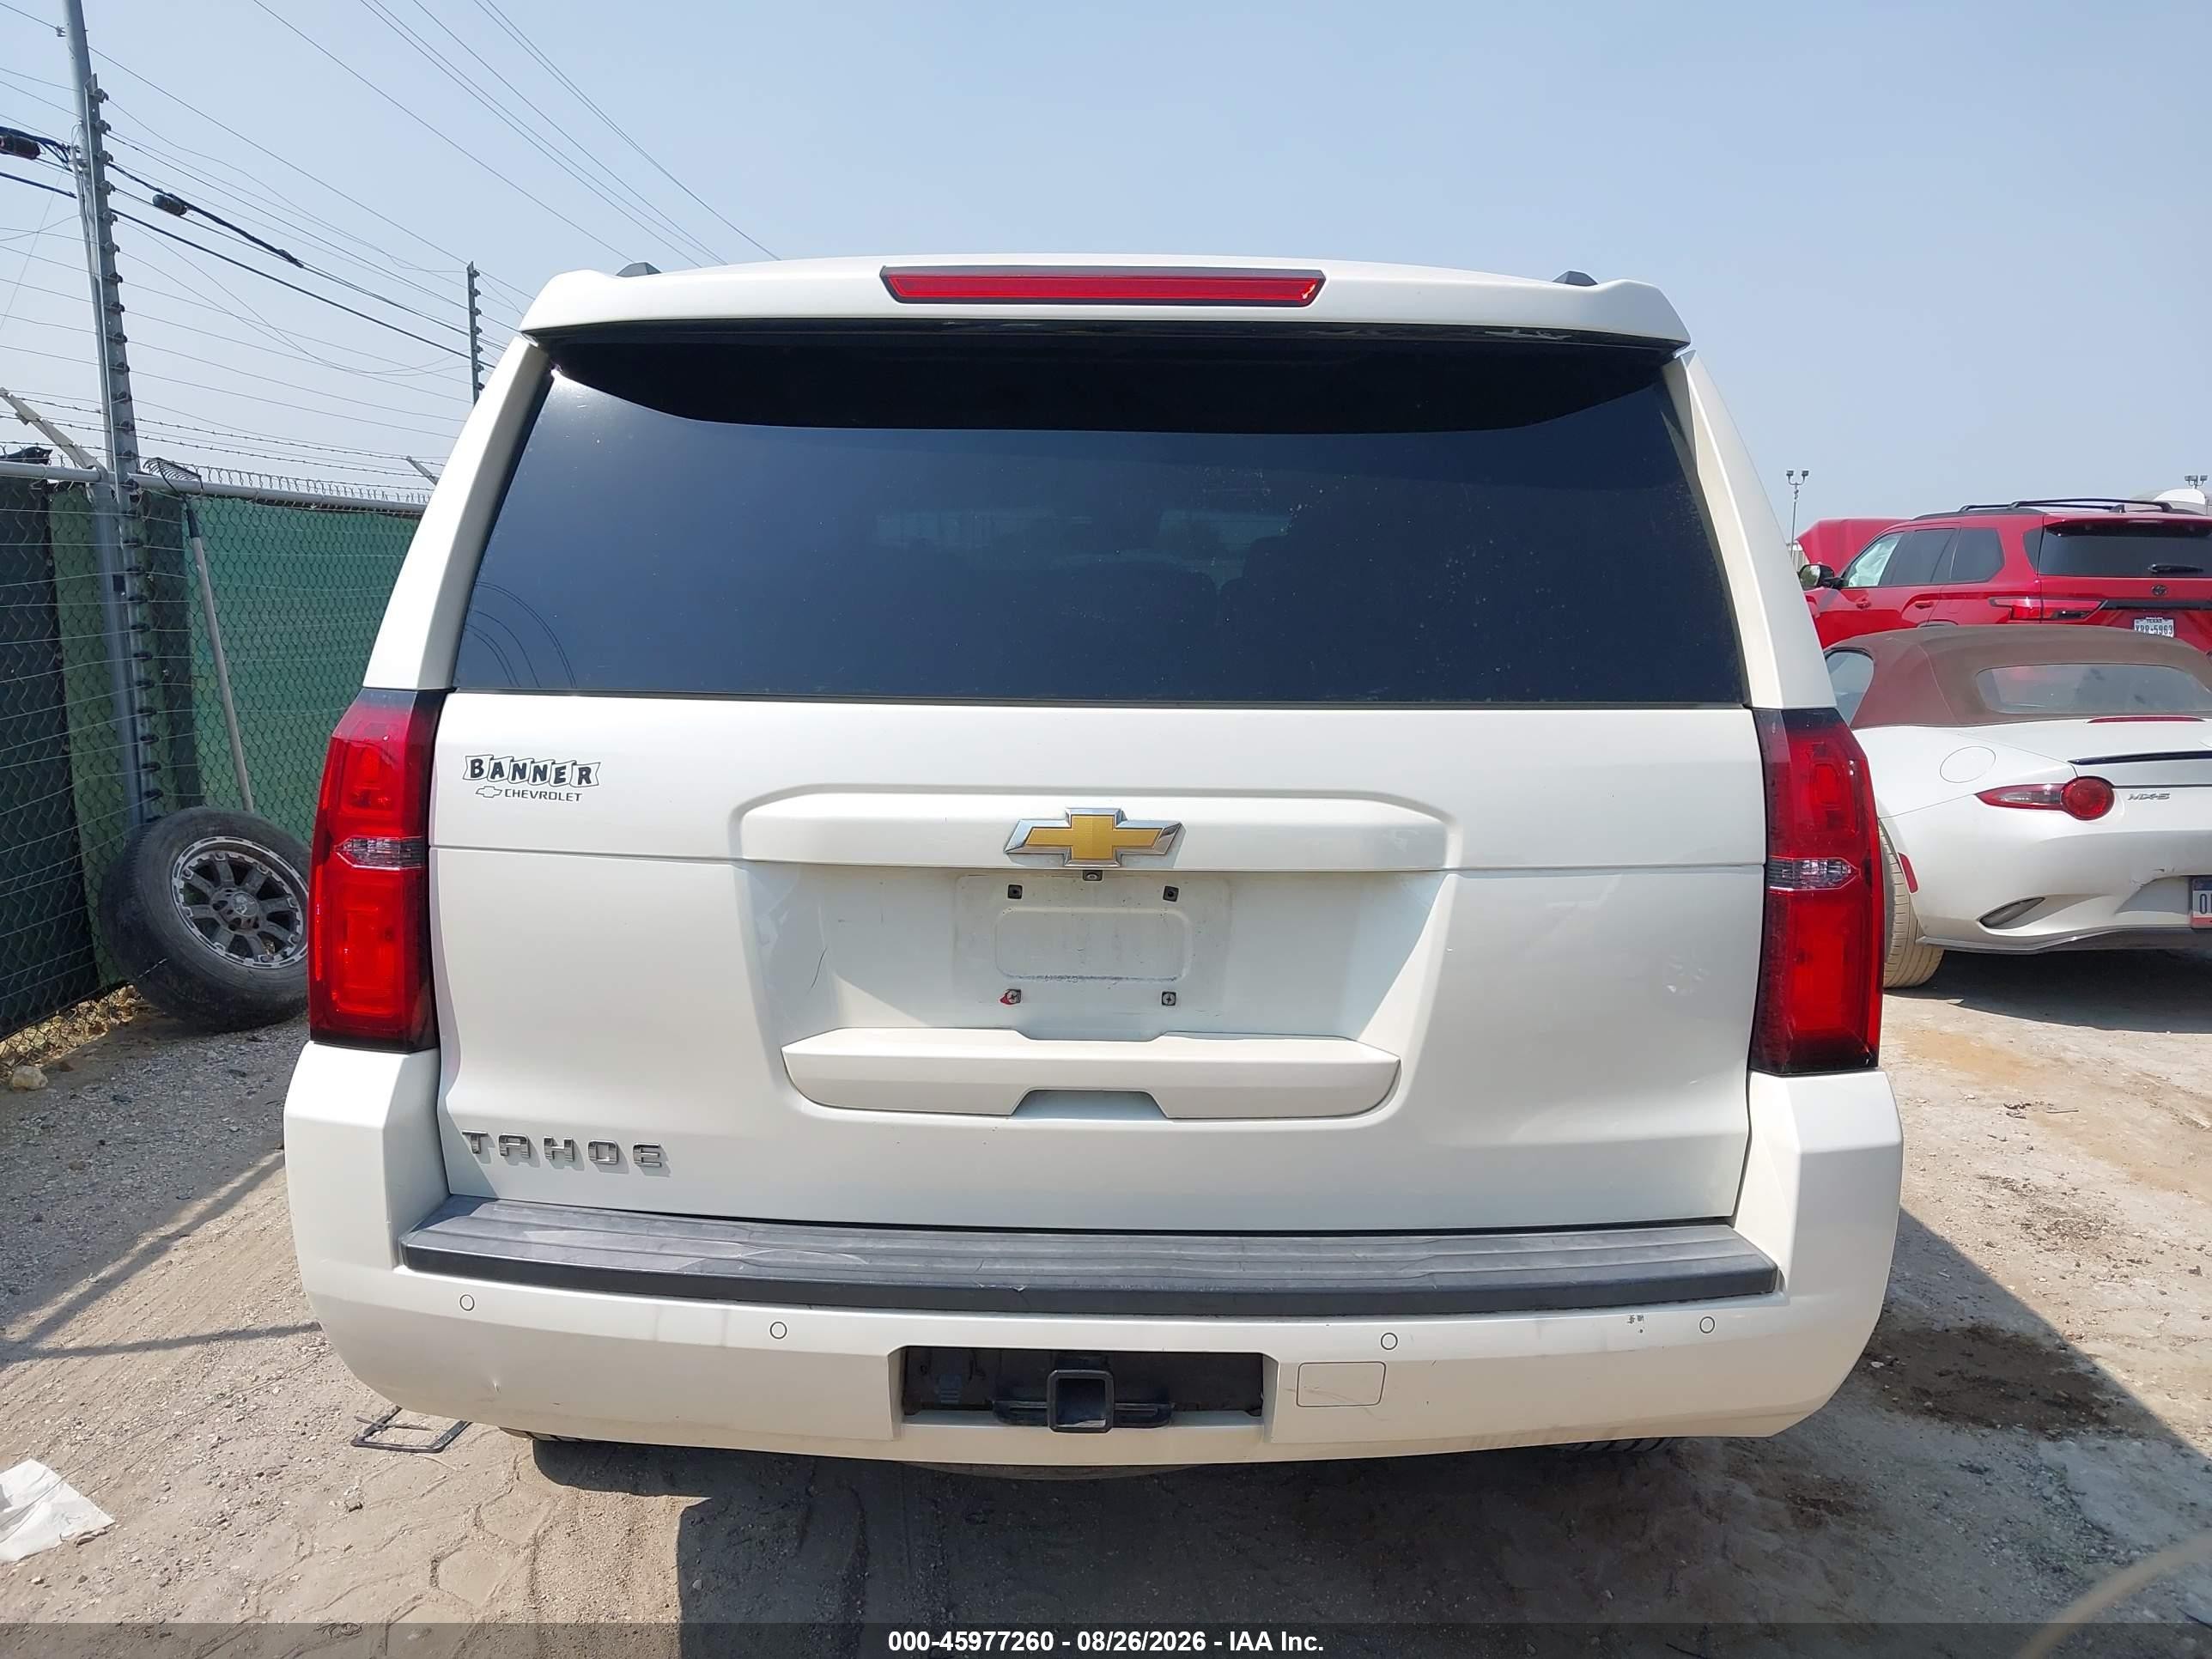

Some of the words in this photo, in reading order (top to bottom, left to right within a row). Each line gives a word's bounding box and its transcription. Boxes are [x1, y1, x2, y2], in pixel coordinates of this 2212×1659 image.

[469, 757, 593, 786] BANNER
[504, 787, 583, 803] CHEVROLET
[2127, 793, 2171, 801] MX-5
[462, 1129, 663, 1169] TAHOE
